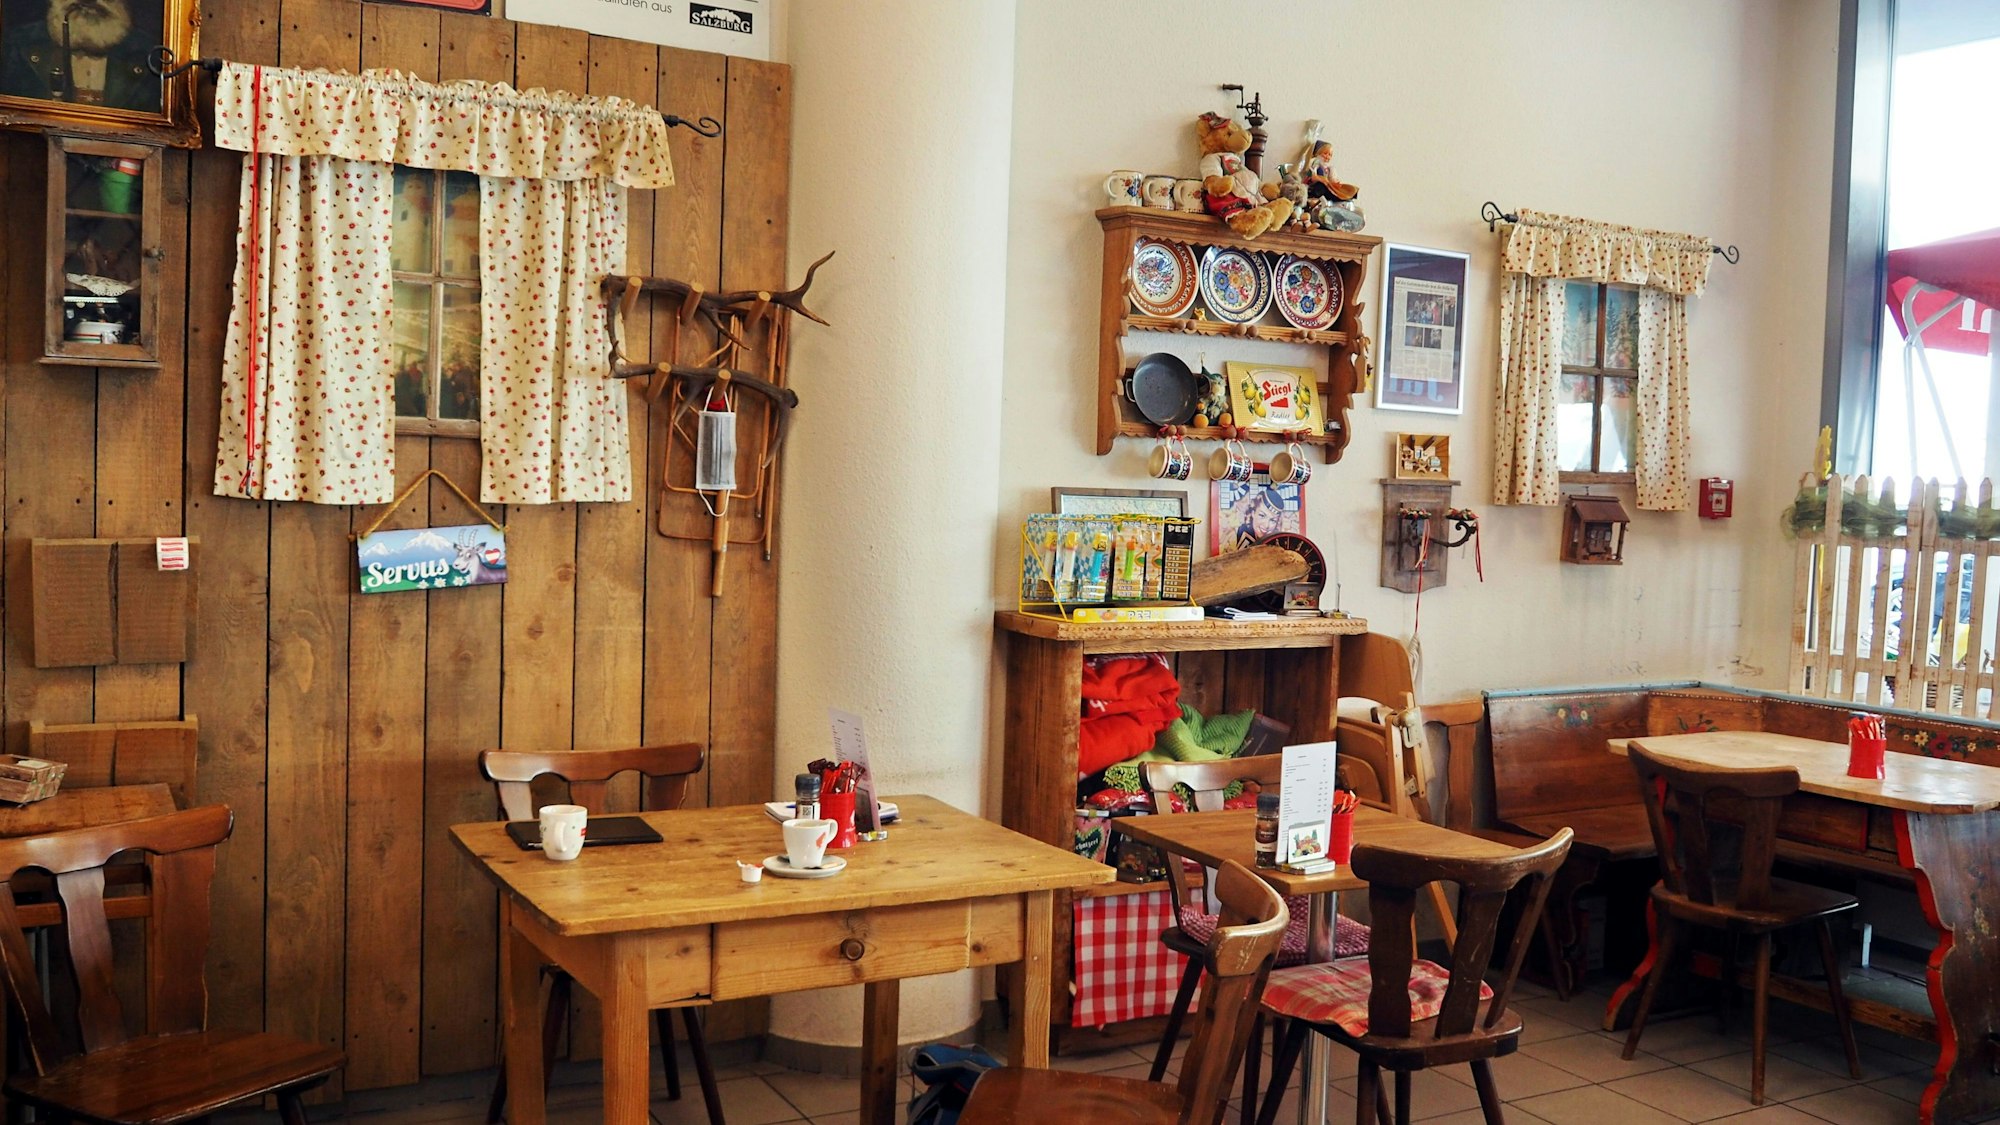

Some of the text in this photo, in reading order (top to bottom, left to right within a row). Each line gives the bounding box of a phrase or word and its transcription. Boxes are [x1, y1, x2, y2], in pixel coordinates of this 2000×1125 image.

[651, 2, 672, 14] aus
[691, 11, 751, 33] SALZBURG
[1262, 380, 1292, 401] Stiegl
[1167, 524, 1189, 533] PEZ
[366, 557, 450, 588] Servus
